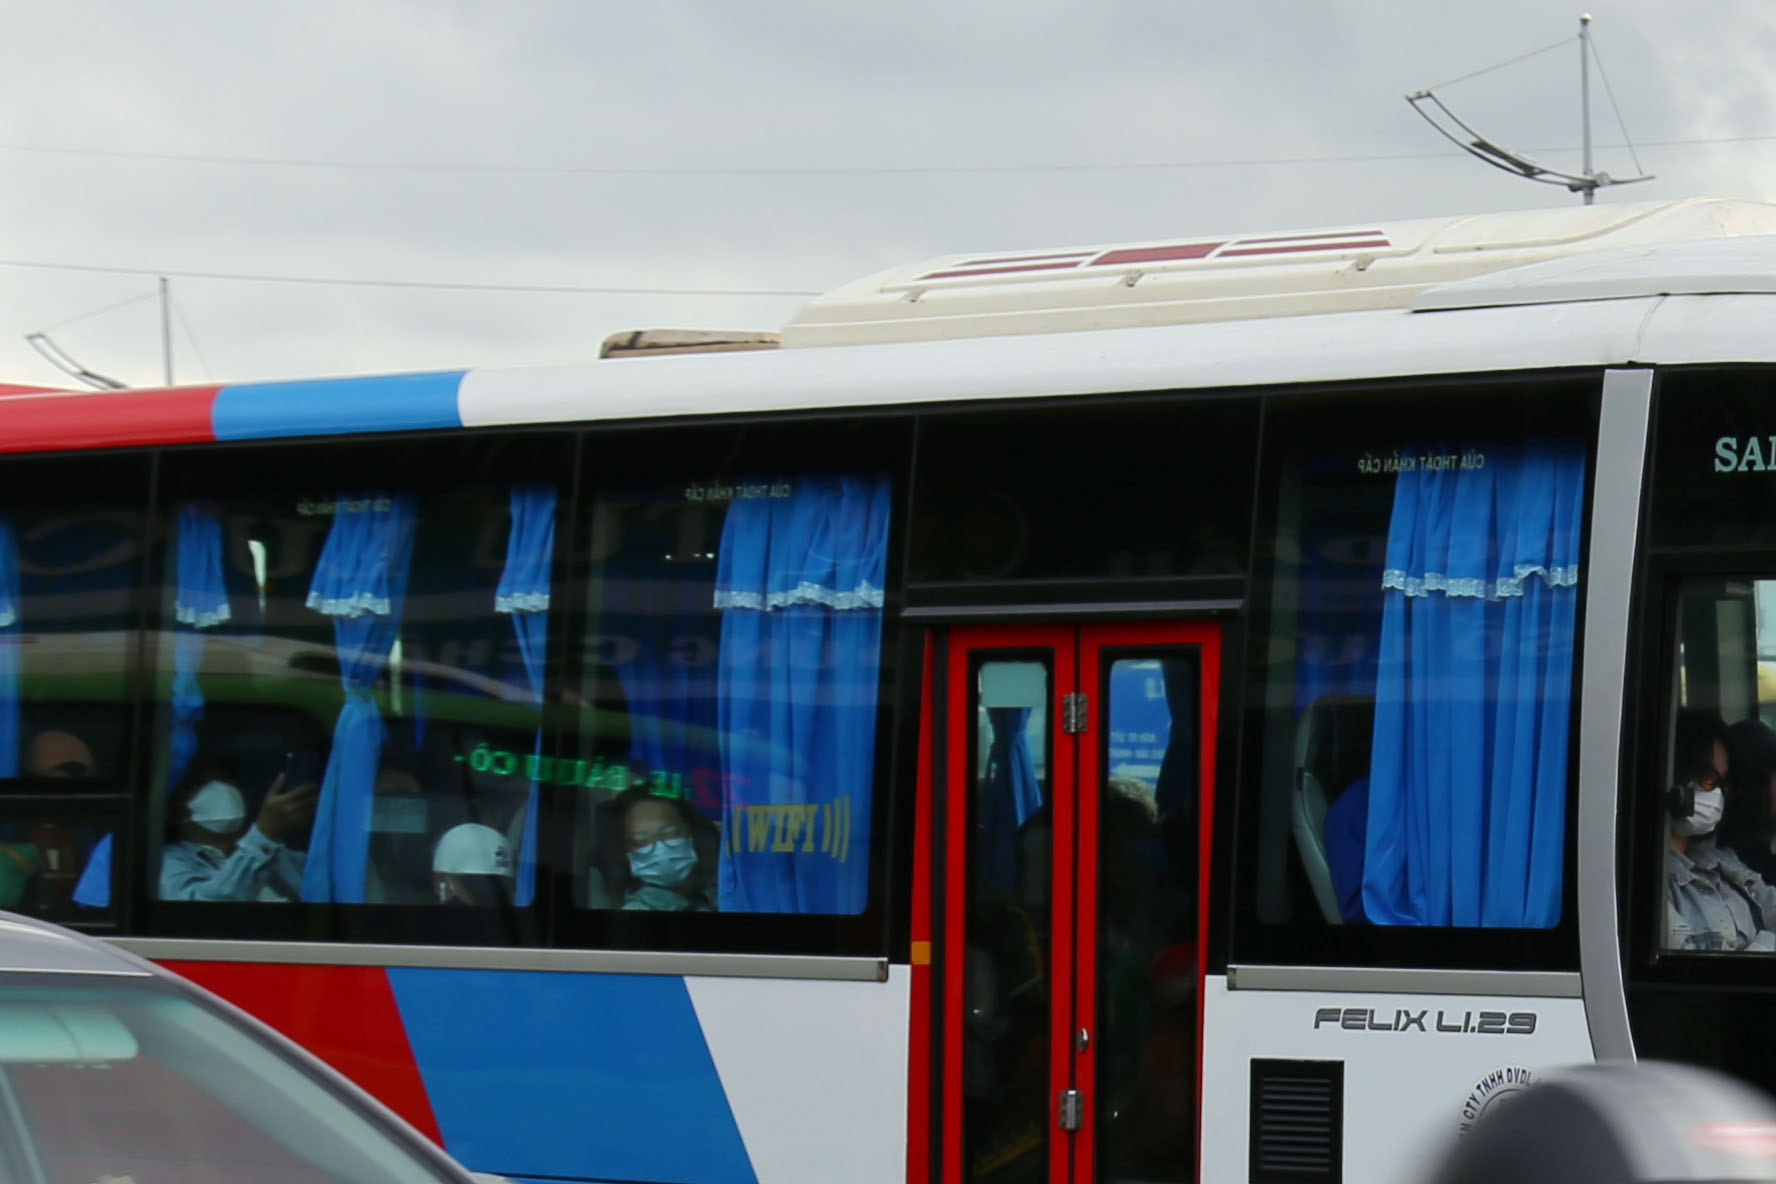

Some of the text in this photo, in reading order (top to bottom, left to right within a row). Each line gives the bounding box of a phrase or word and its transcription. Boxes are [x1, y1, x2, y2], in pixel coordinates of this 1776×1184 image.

[1314, 1008, 1429, 1032] FELIX
[1463, 1093, 1480, 1120] CTY
[1476, 1069, 1504, 1097] TNHH
